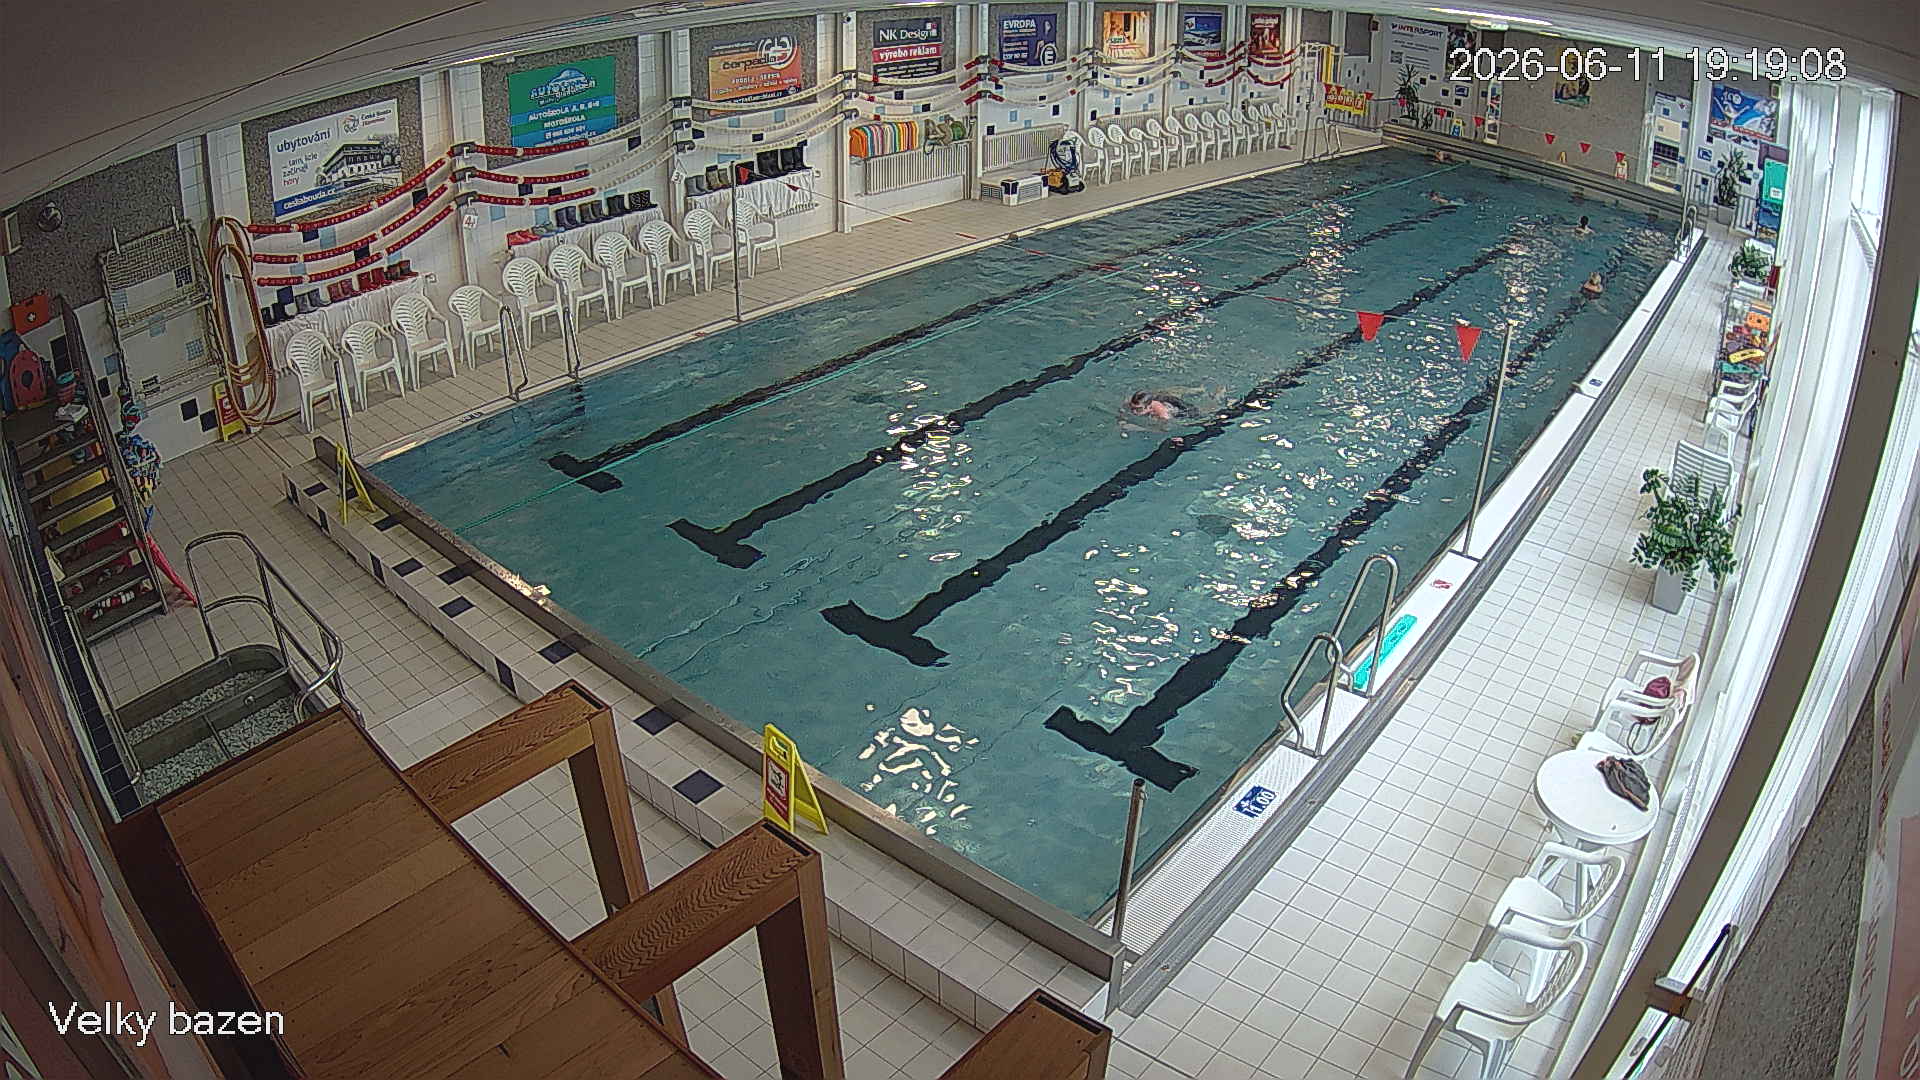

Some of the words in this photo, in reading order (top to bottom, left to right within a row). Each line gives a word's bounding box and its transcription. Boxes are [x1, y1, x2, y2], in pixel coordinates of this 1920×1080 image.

[1003, 19, 1036, 29] EVROPA
[1398, 24, 1443, 37] INTERSPORT
[880, 29, 897, 42] NK
[909, 46, 937, 57] reklam
[276, 127, 331, 153] ubytování
